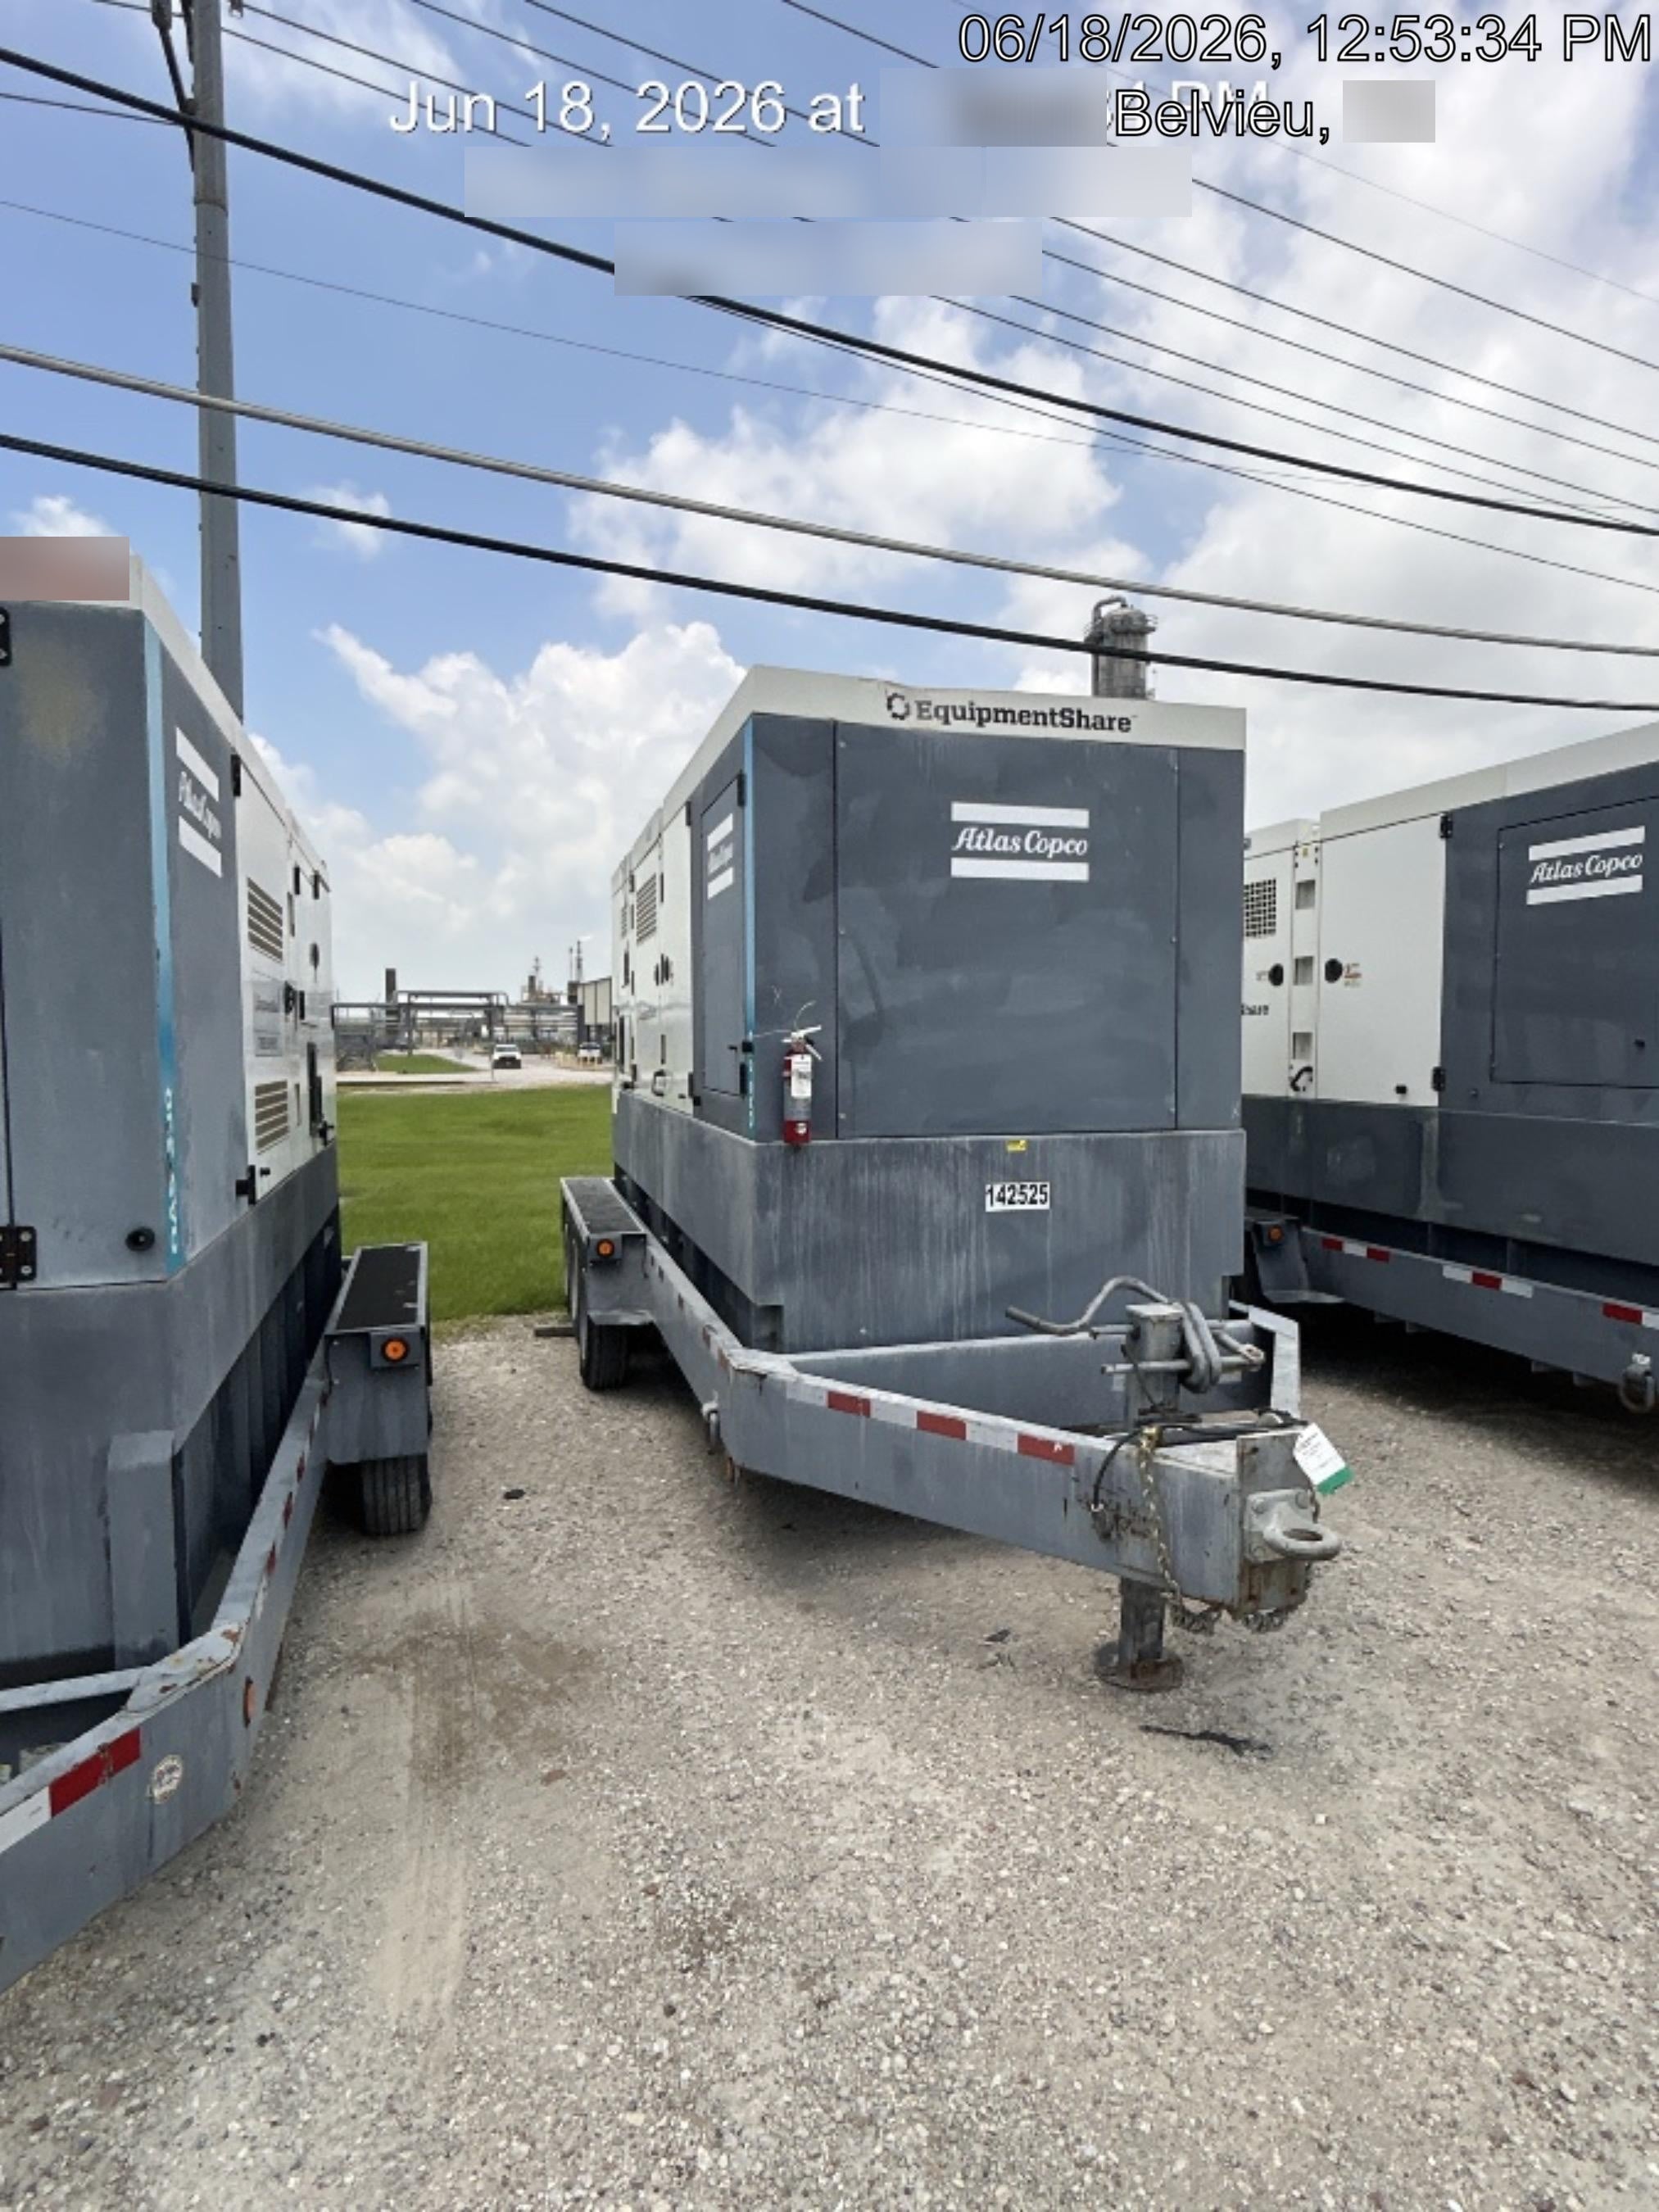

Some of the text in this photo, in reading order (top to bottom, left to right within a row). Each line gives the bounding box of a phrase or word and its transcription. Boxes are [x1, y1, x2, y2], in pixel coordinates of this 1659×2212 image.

[916, 700, 1132, 732] EquipmentShare
[953, 827, 1087, 858] Atlas Copco
[1530, 854, 1643, 883] Atlas Copco
[986, 1184, 1048, 1206] 142525
